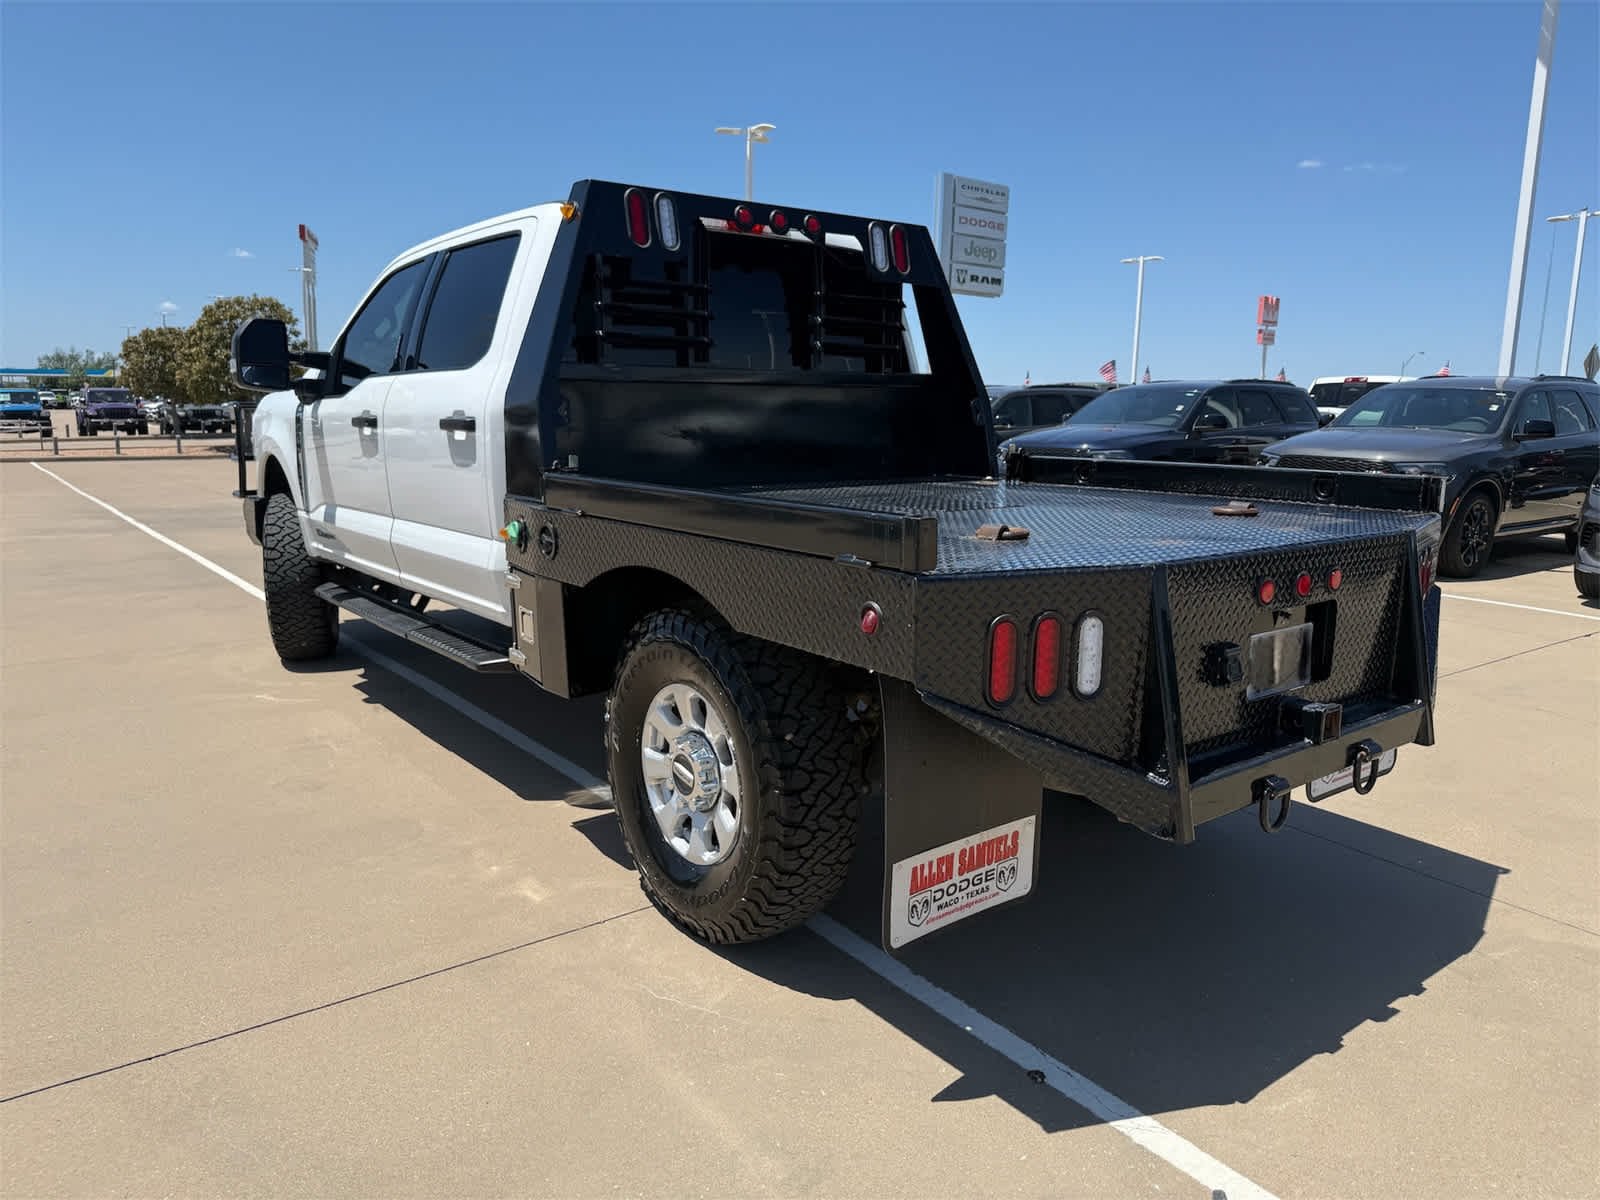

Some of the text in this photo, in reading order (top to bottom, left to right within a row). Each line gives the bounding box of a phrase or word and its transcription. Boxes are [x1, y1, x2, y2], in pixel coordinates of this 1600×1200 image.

[961, 184, 1006, 197] CHRYSLER
[959, 215, 1004, 232] DODGE
[964, 240, 997, 262] Jeep
[970, 274, 1002, 286] RAM
[909, 830, 1019, 896] ALLEN SAMUELS
[933, 868, 996, 903] DODGE
[936, 885, 990, 912] WACO TEXAS
